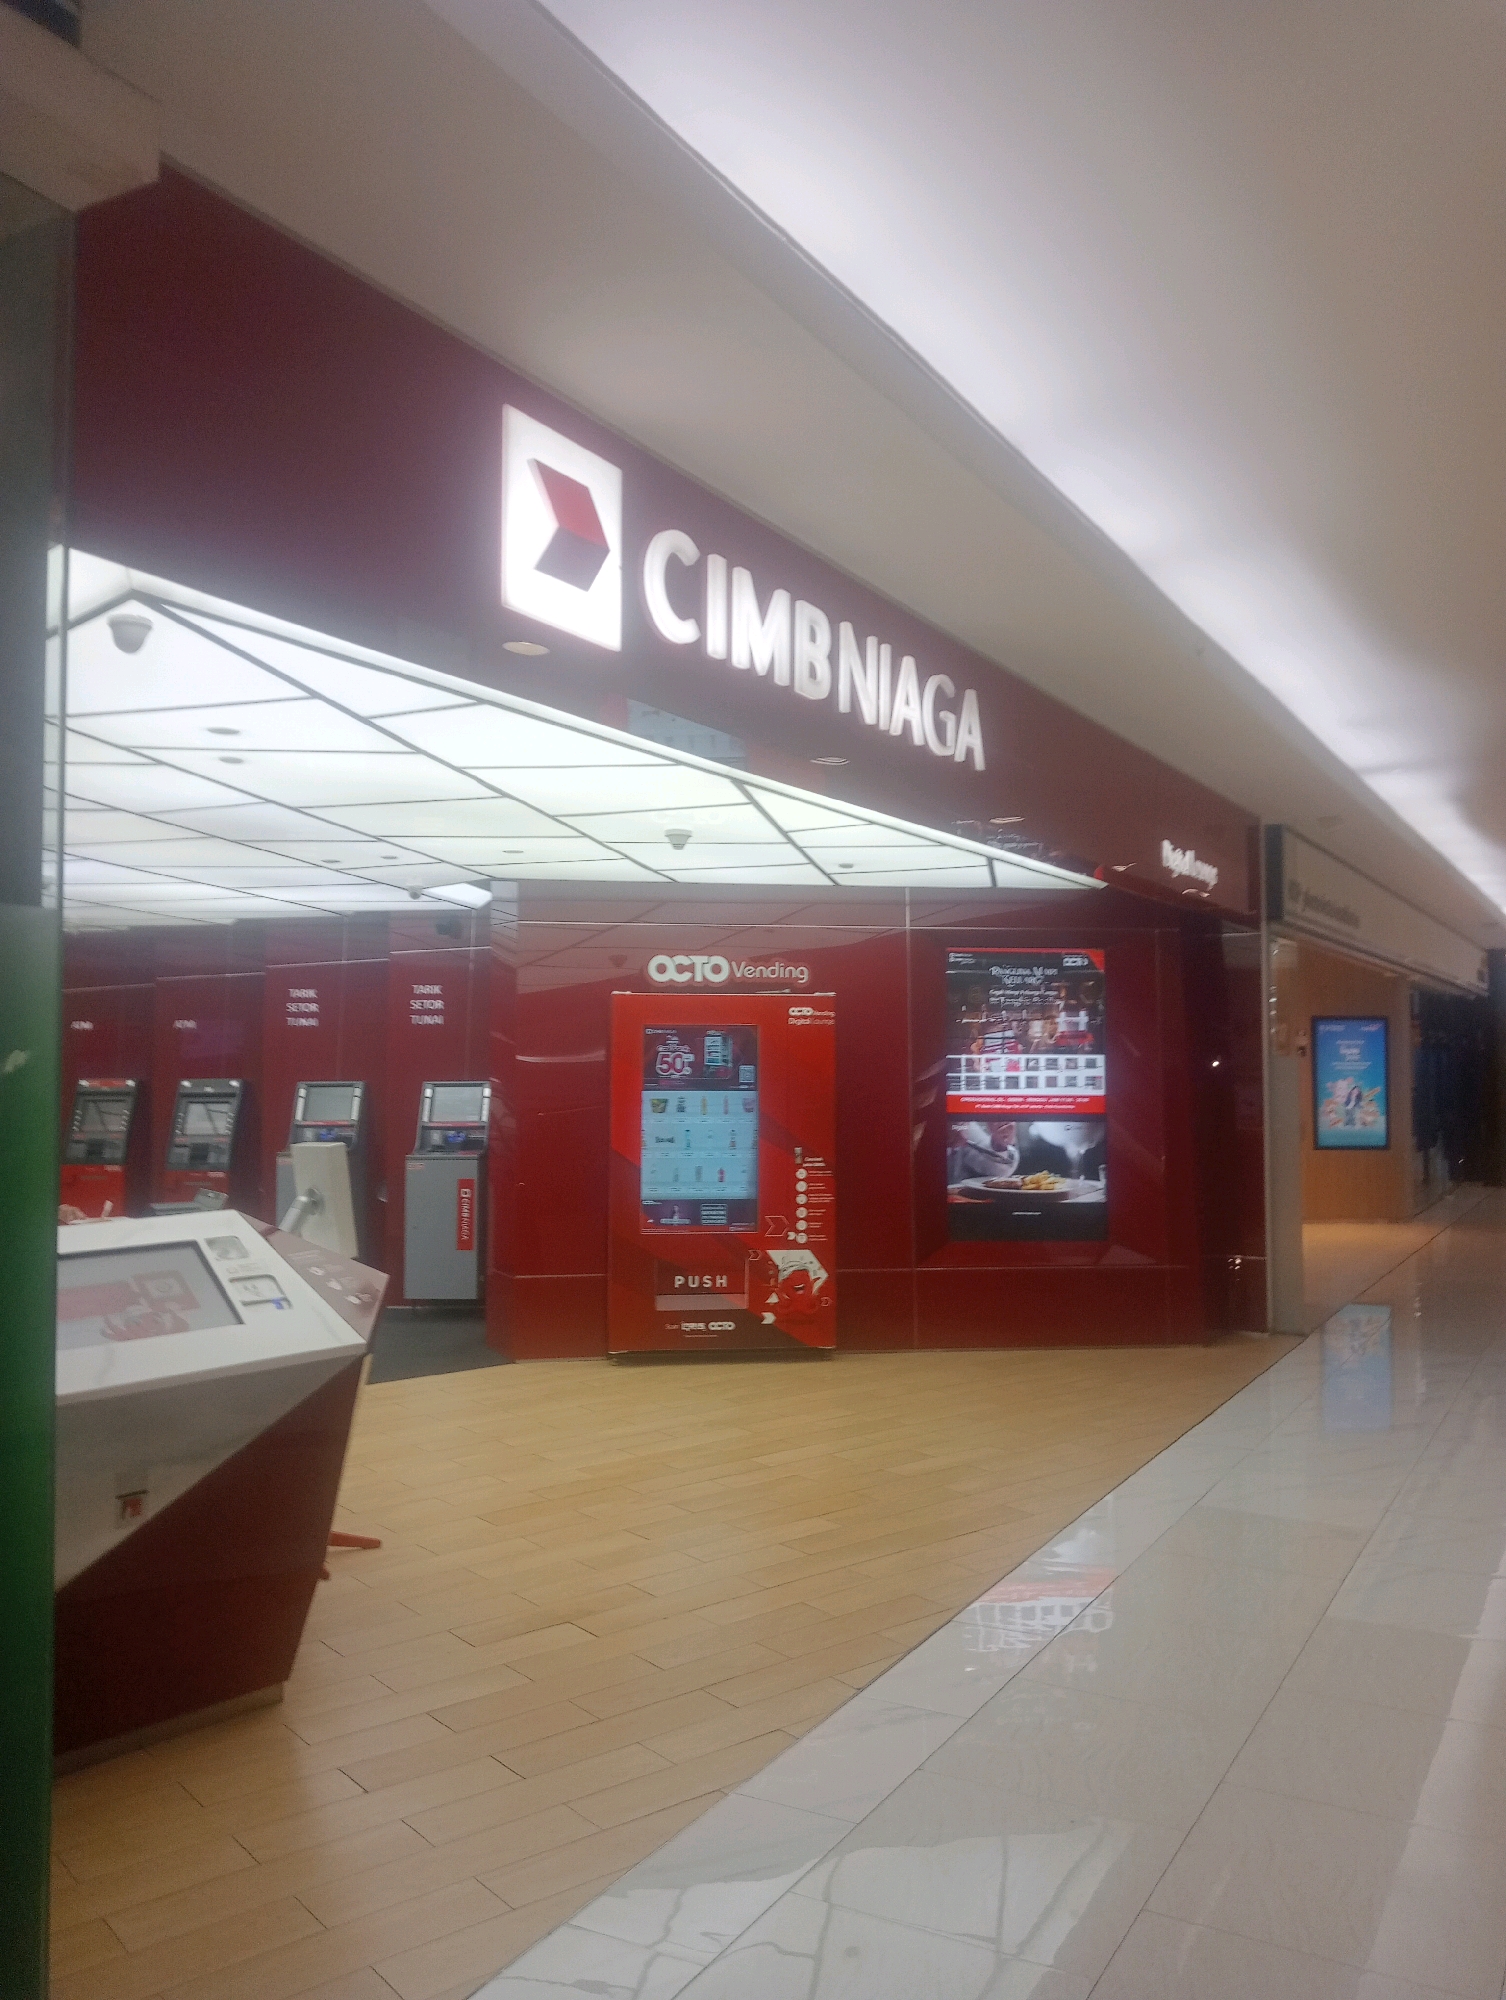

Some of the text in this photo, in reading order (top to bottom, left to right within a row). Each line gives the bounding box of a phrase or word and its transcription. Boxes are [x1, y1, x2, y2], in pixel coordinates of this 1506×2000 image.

[647, 954, 810, 983] OCTO Vending
[288, 988, 318, 999] TARIK
[411, 984, 443, 995] TARIK
[285, 1002, 320, 1013] SETOR
[409, 999, 445, 1010] SETOR
[285, 1017, 320, 1027] TUNAI
[409, 1014, 445, 1025] TUNAI
[674, 1275, 728, 1288] PUSH
